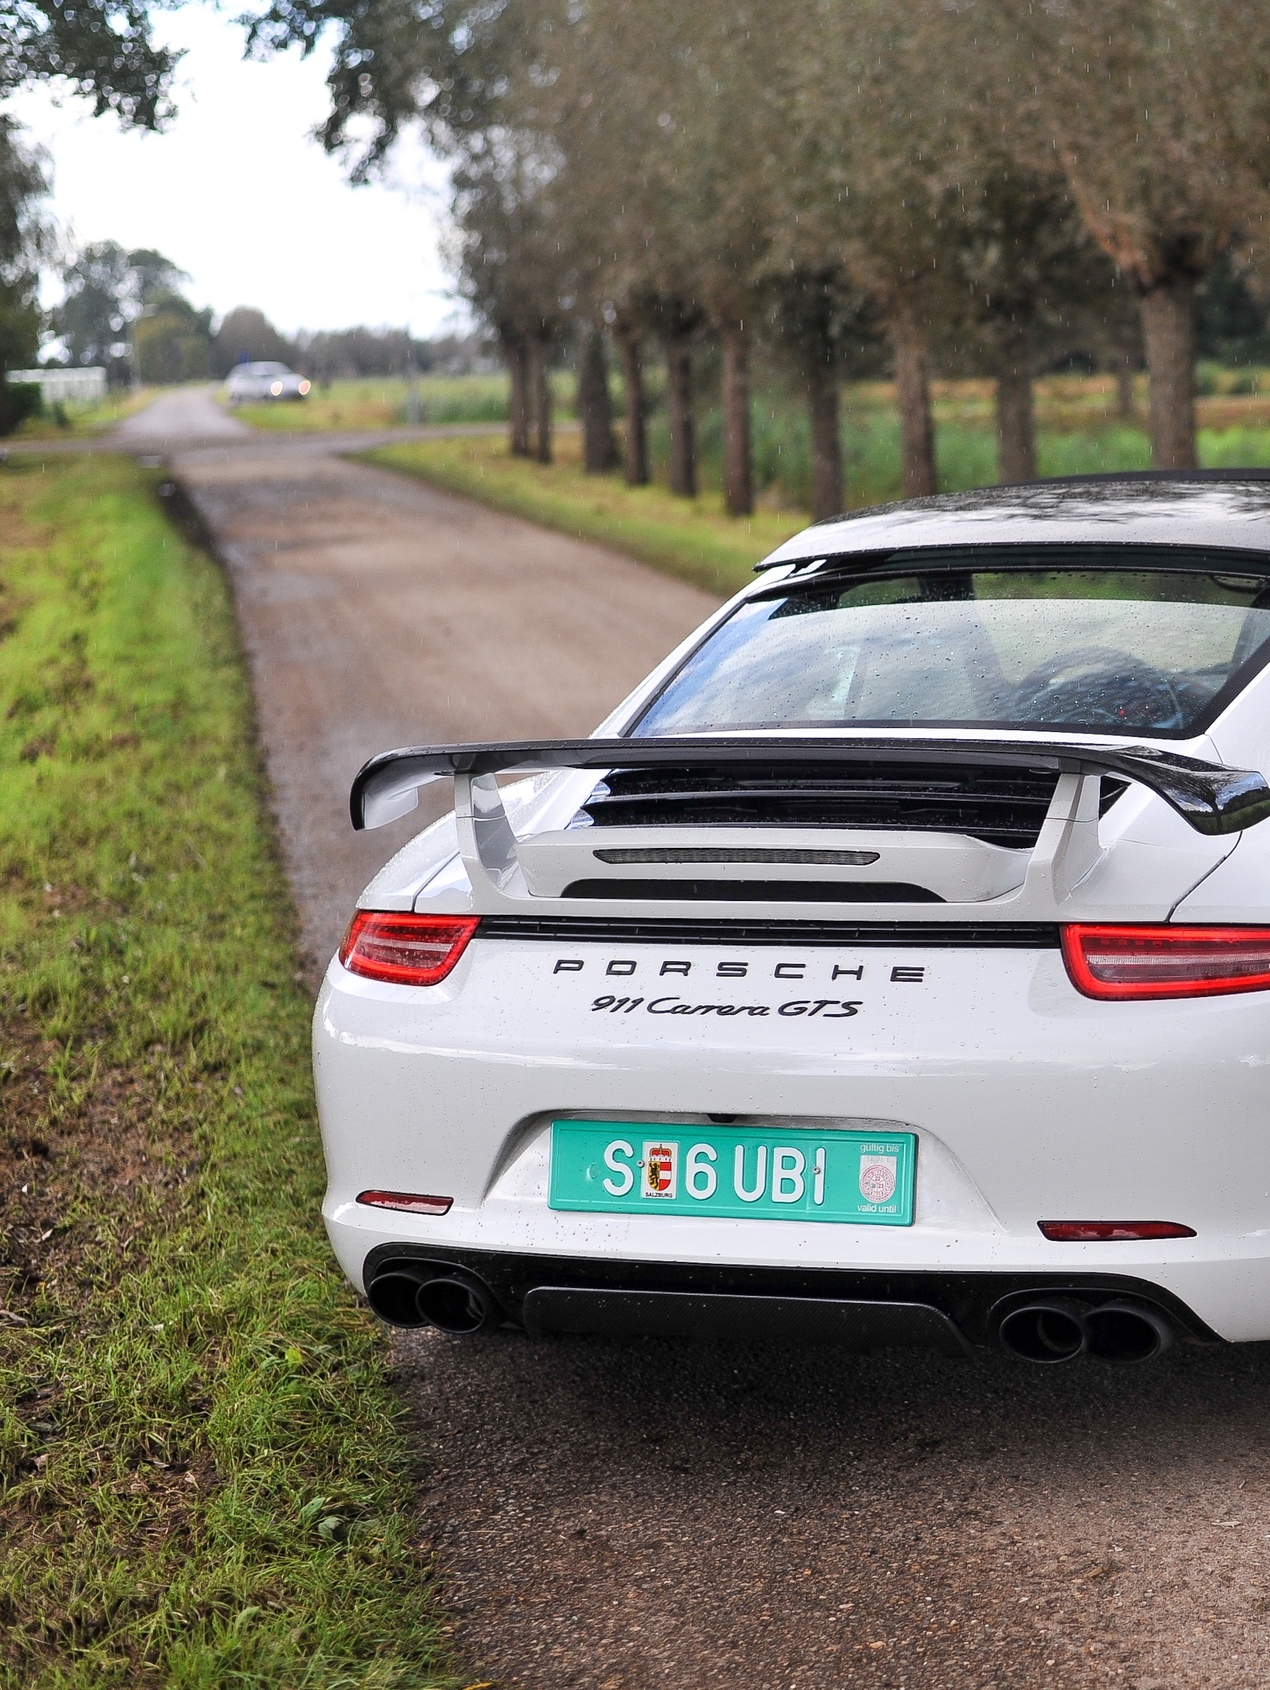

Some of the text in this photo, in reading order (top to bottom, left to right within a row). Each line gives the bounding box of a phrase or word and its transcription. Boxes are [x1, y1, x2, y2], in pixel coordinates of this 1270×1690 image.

[553, 959, 925, 982] PORSCHE
[591, 995, 862, 1017] 911 Carrera GTS
[886, 1144, 899, 1153] bis
[602, 1140, 635, 1197] S
[685, 1142, 718, 1200] 6
[857, 1203, 897, 1214] valid until
